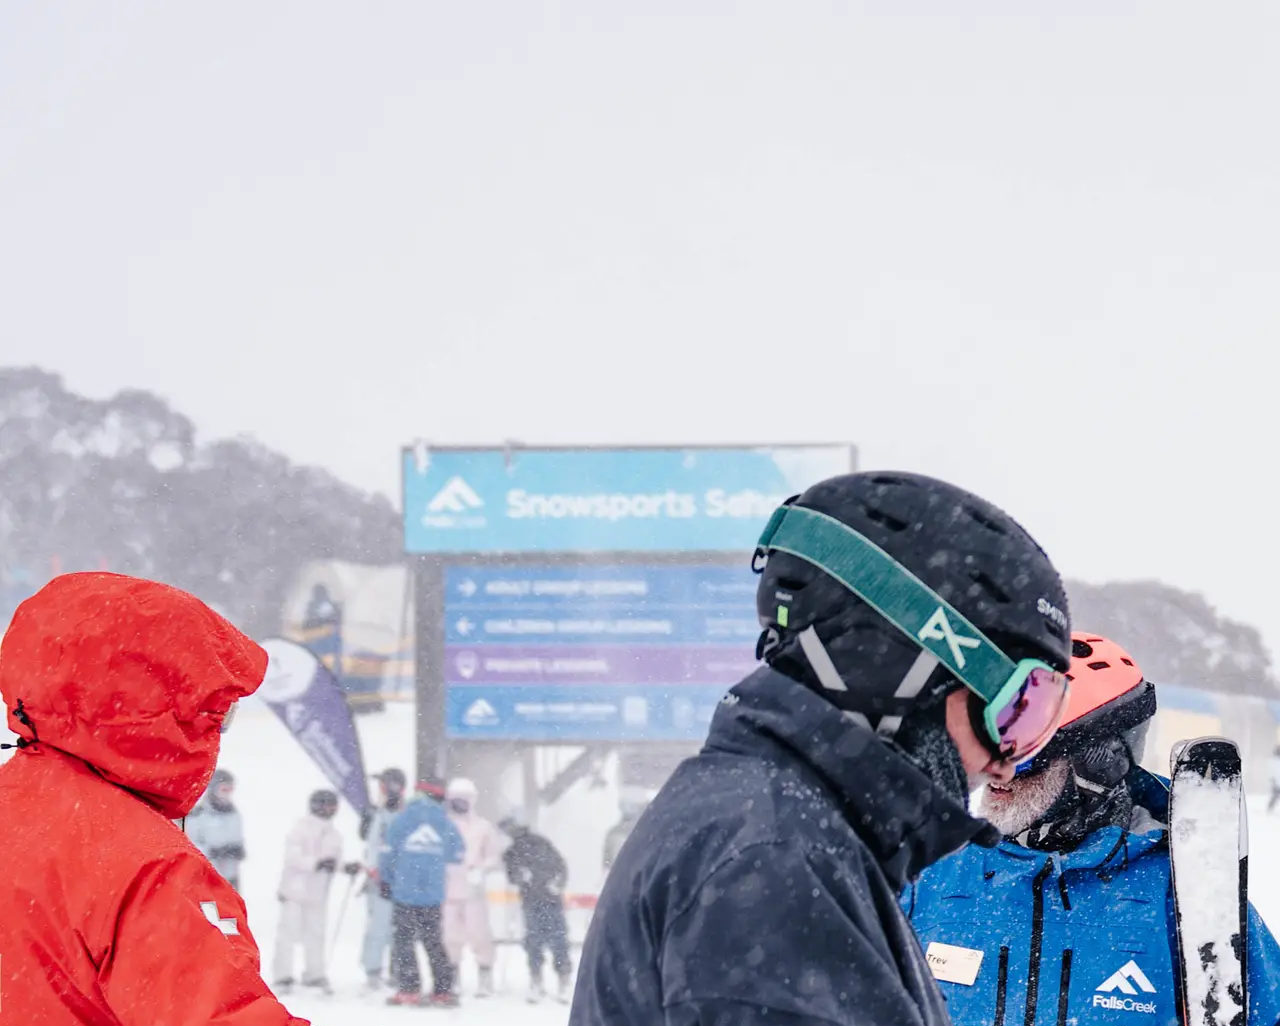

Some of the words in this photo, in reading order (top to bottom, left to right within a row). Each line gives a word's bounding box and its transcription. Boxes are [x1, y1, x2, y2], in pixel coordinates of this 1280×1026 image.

[506, 488, 696, 520] Snowsports
[705, 488, 786, 518] Scho
[927, 953, 948, 965] Trev
[1093, 995, 1157, 1014] FallsCreek
